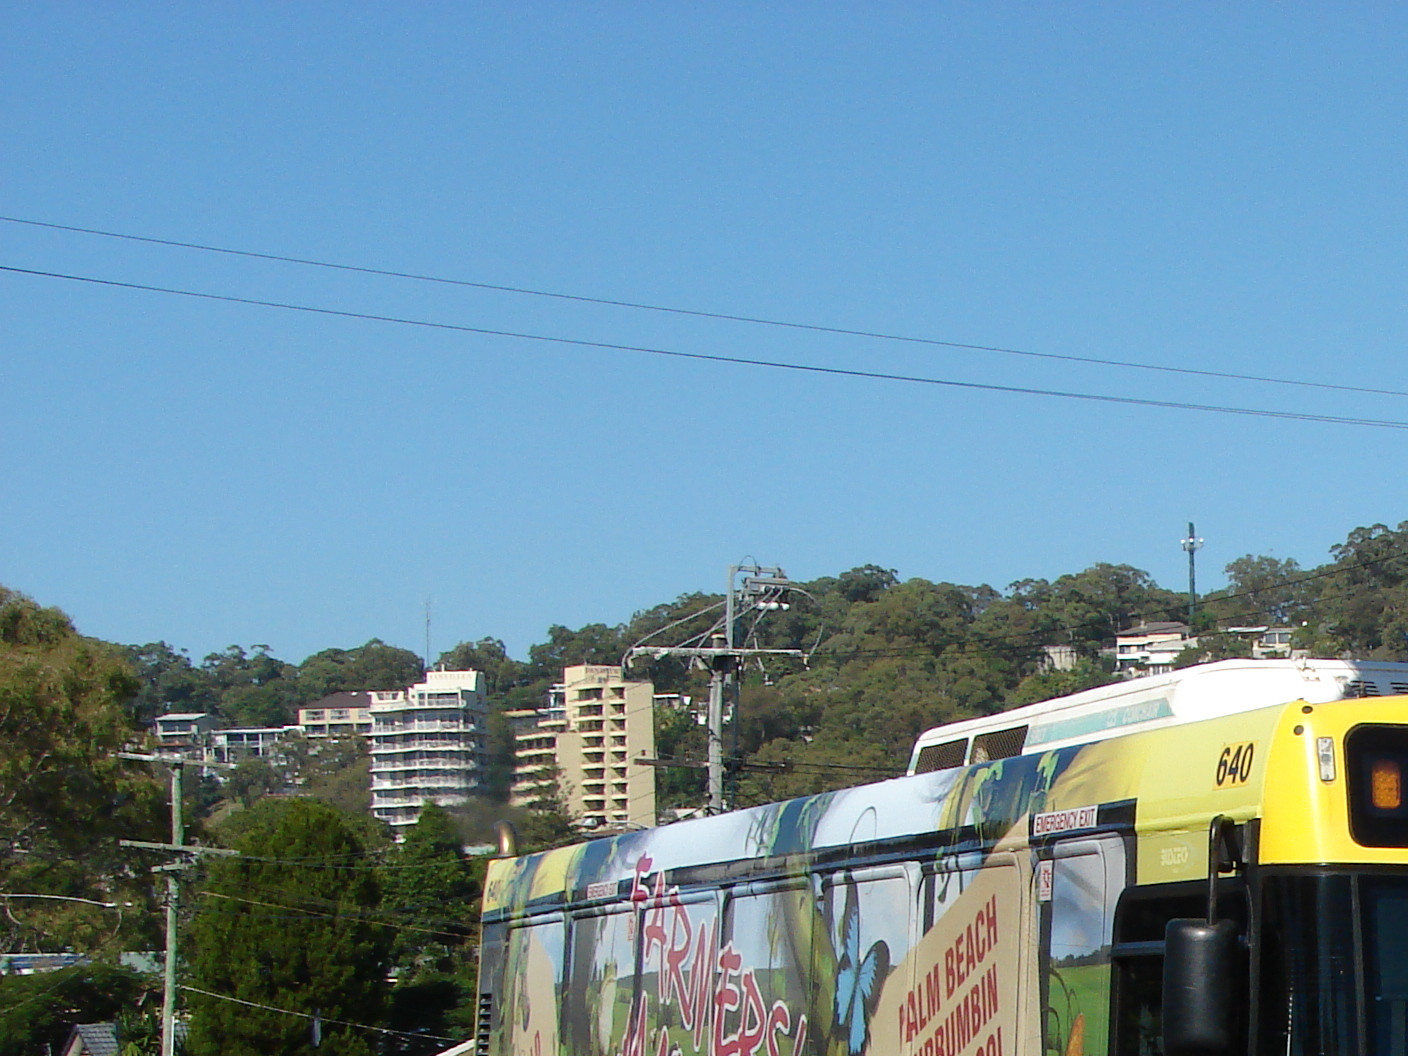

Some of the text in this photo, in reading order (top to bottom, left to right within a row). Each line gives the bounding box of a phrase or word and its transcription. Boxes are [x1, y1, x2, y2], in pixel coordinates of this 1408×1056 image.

[1216, 742, 1254, 787] 640
[1035, 808, 1096, 834] EMERGENCY EXIT
[945, 893, 999, 1000] BEACH
